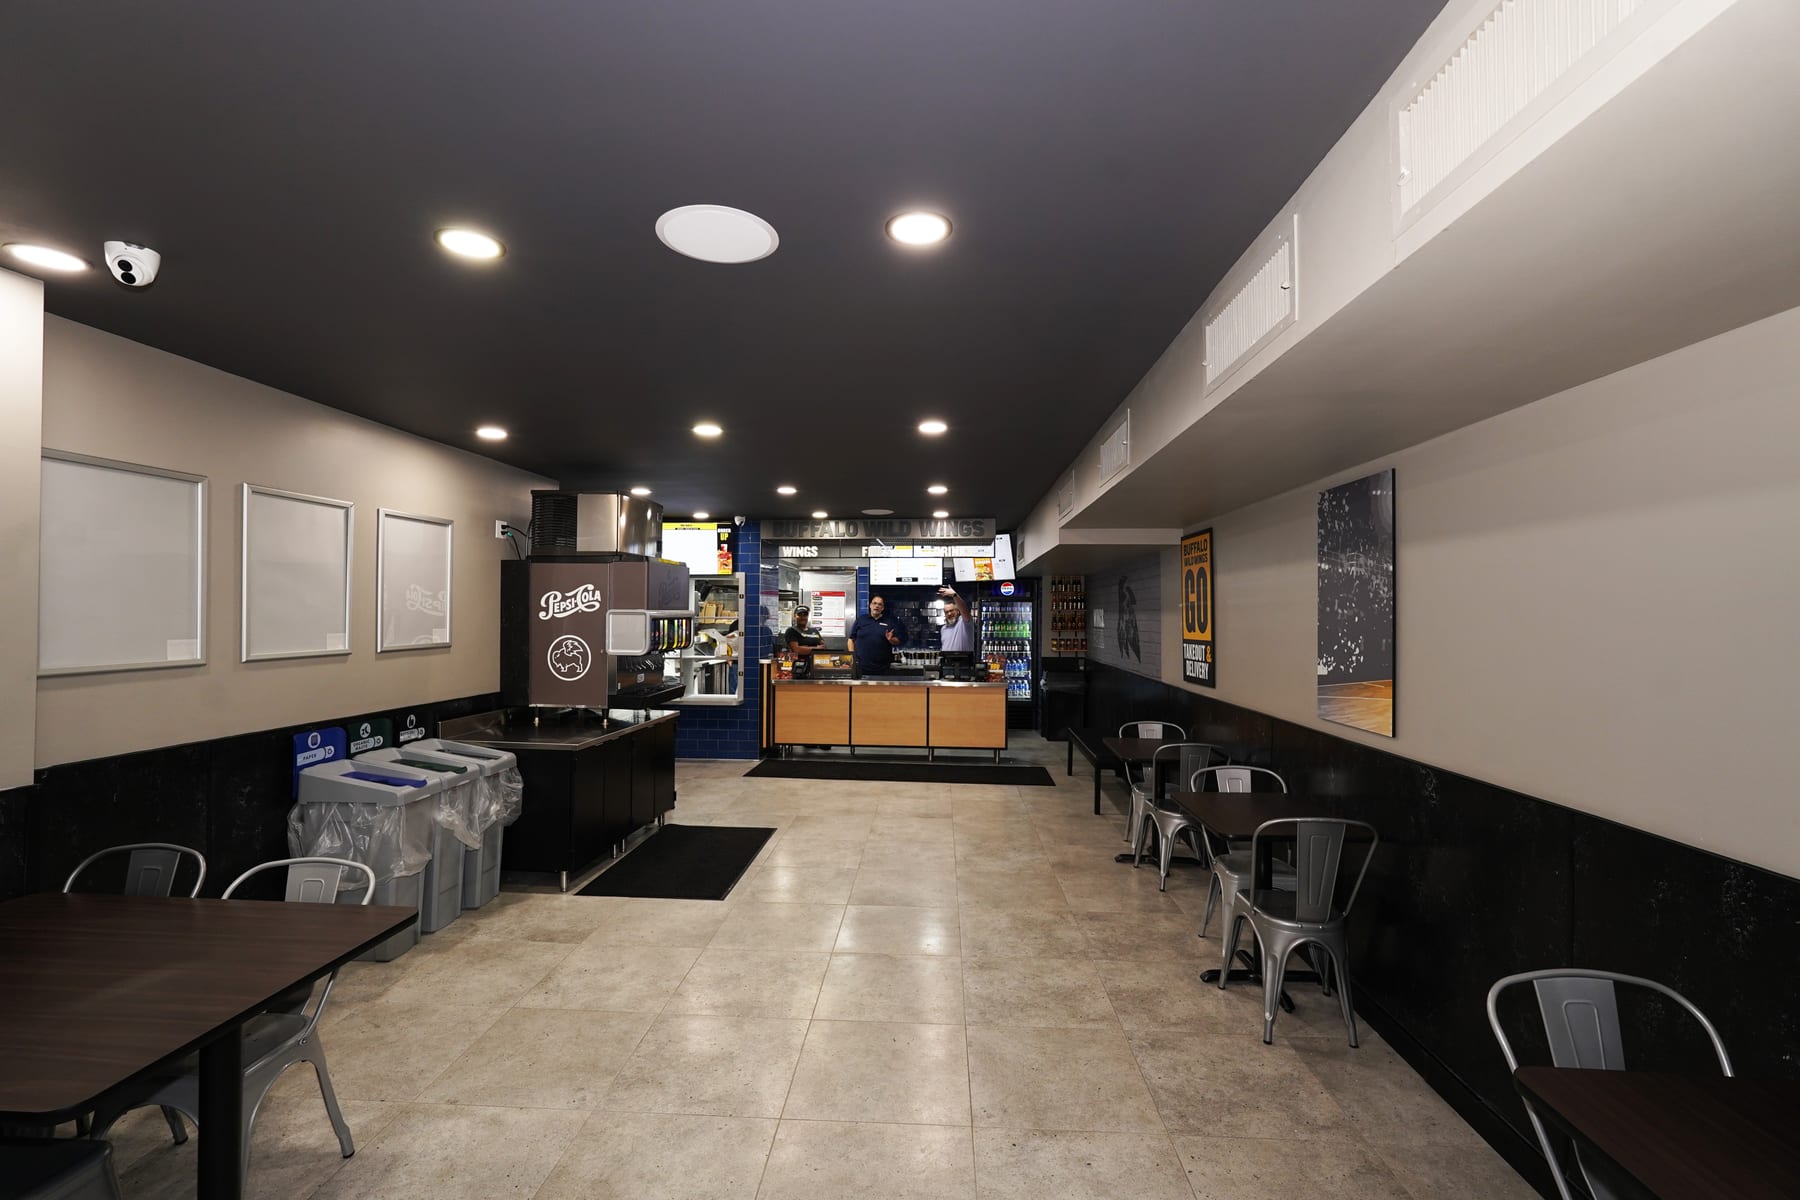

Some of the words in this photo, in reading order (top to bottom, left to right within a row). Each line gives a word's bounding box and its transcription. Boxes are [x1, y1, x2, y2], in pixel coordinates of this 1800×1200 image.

[773, 519, 859, 537] BUFFALO
[863, 519, 912, 537] WILD
[920, 519, 985, 537] WINGS
[782, 546, 819, 557] WINGS
[1183, 539, 1208, 556] BUFFALO
[1183, 556, 1194, 567] WILD
[1194, 553, 1208, 565] WINGS
[1185, 566, 1208, 634] GO
[1183, 643, 1206, 661] TAKEOUT
[1206, 645, 1212, 662] &
[1186, 660, 1209, 680] DELIVERY
[303, 753, 317, 761] PAPER
